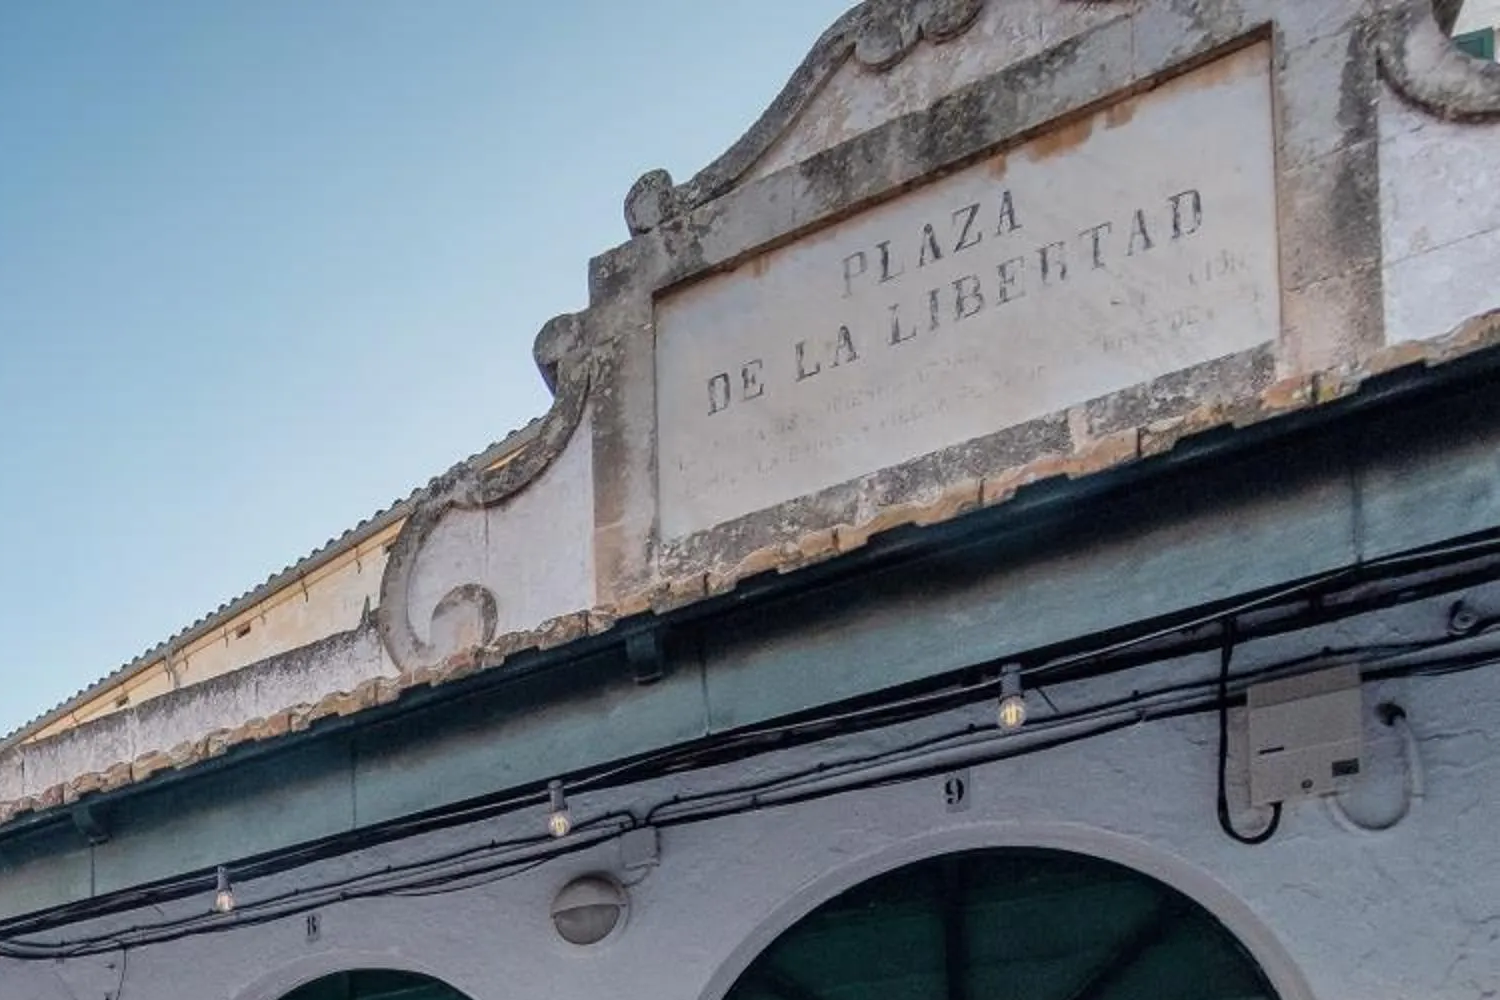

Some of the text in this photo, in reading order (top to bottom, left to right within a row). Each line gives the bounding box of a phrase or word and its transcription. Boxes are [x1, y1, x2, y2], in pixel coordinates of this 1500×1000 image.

[841, 188, 1024, 300] PLAZA
[706, 357, 765, 417] DE
[794, 322, 861, 383] LA
[887, 188, 1204, 348] LIBERTAD
[945, 778, 965, 806] 9
